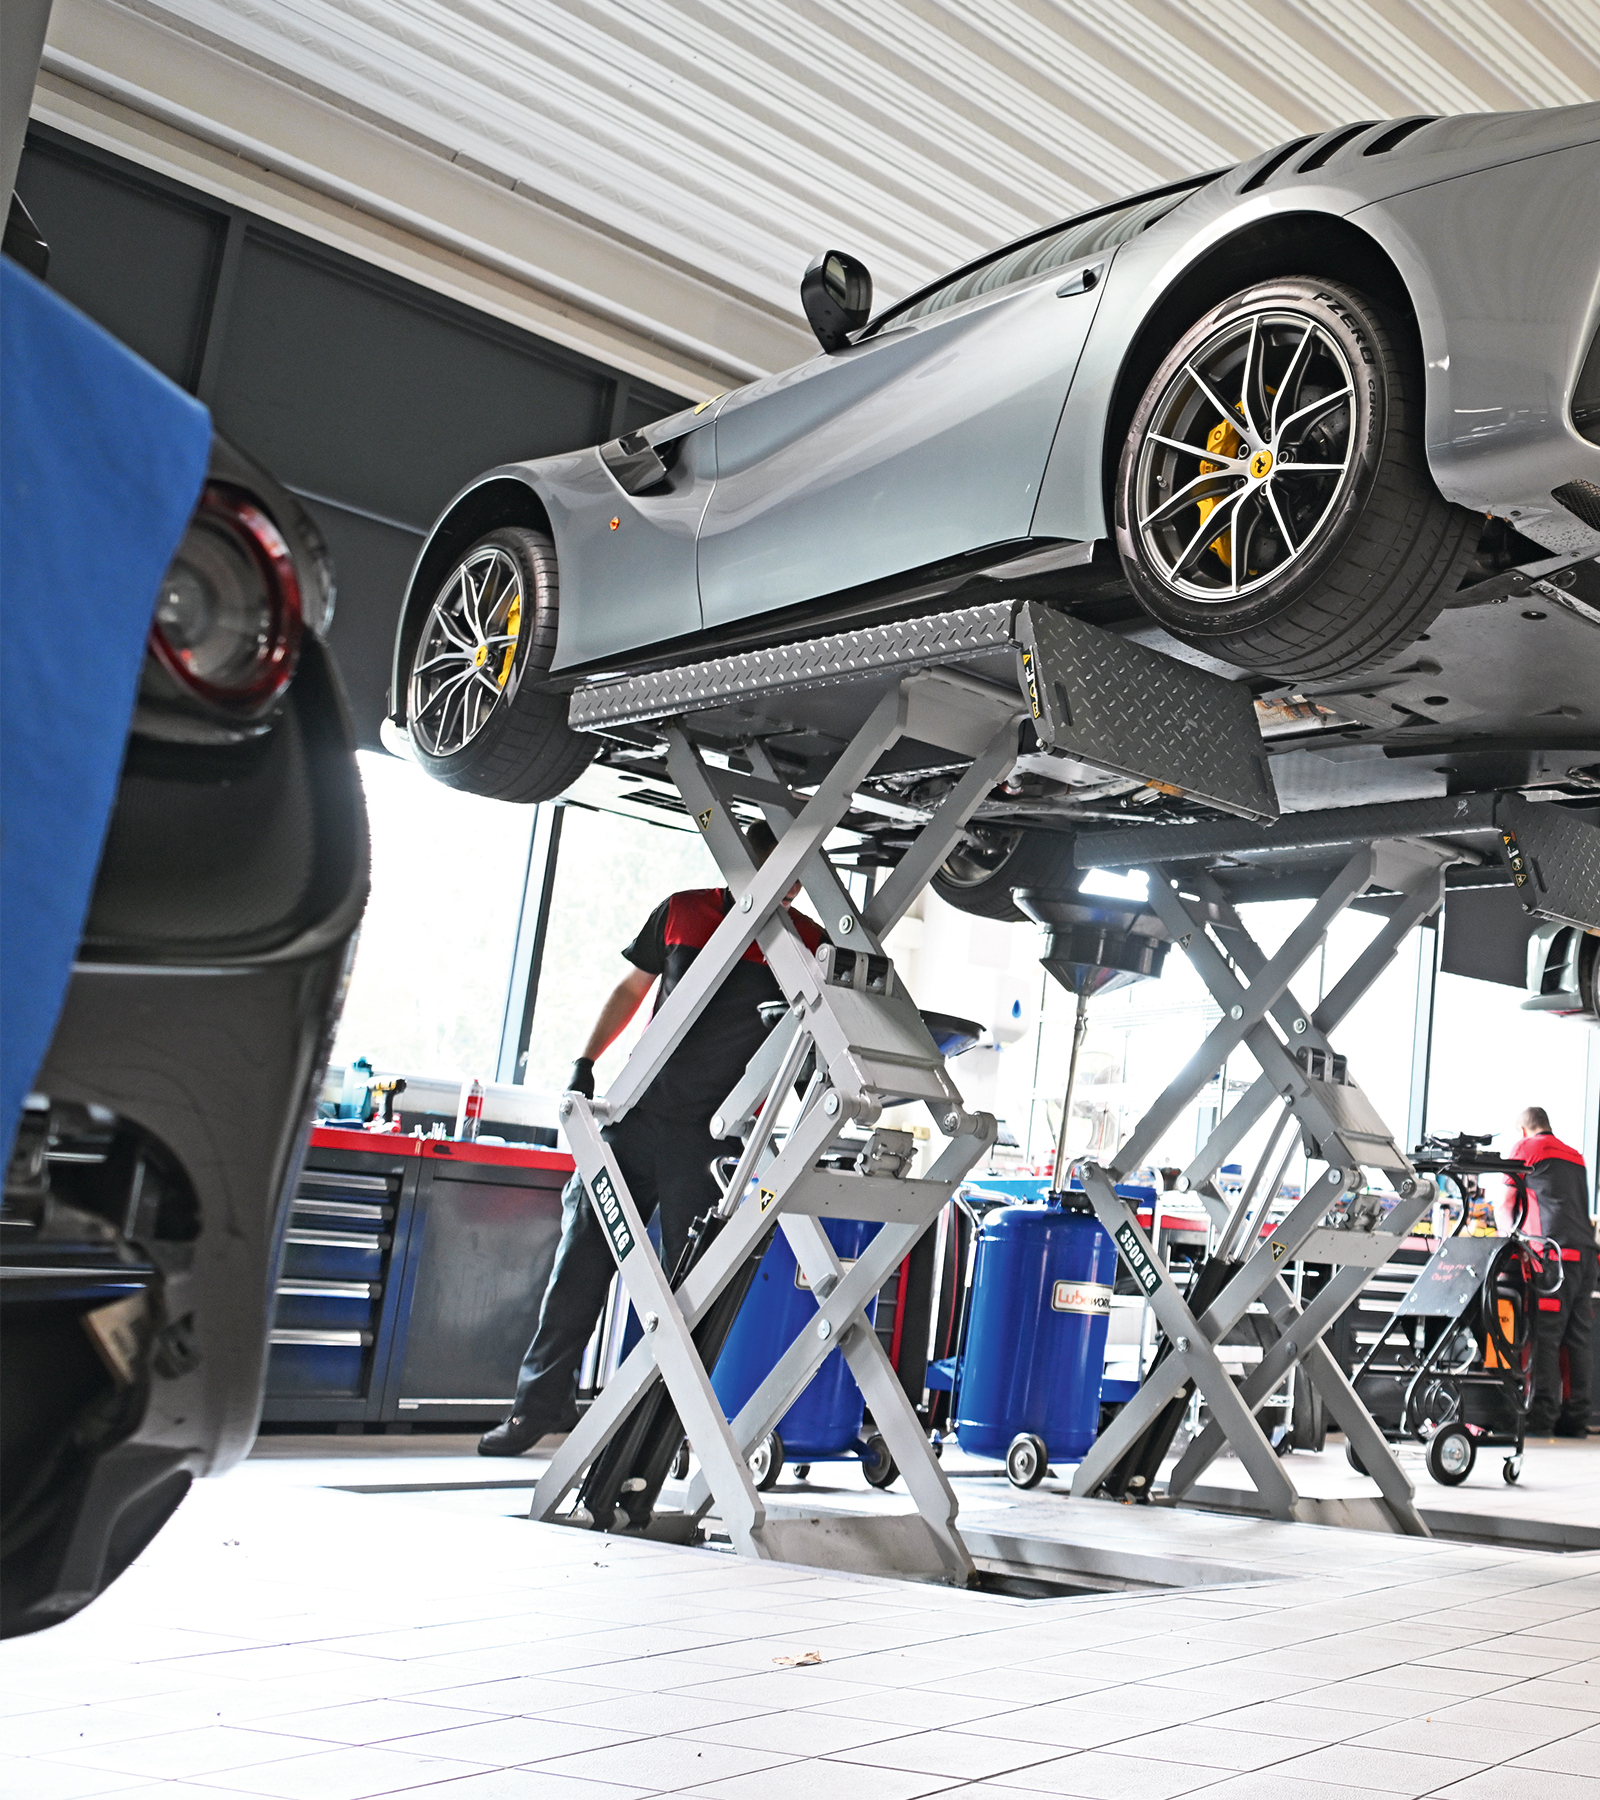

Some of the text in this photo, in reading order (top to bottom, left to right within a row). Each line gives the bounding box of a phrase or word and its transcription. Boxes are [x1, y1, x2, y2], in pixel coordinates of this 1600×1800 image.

[1366, 378, 1378, 446] CORSA
[595, 1176, 630, 1253] 3500 KG
[1120, 1229, 1157, 1289] 3500 KG
